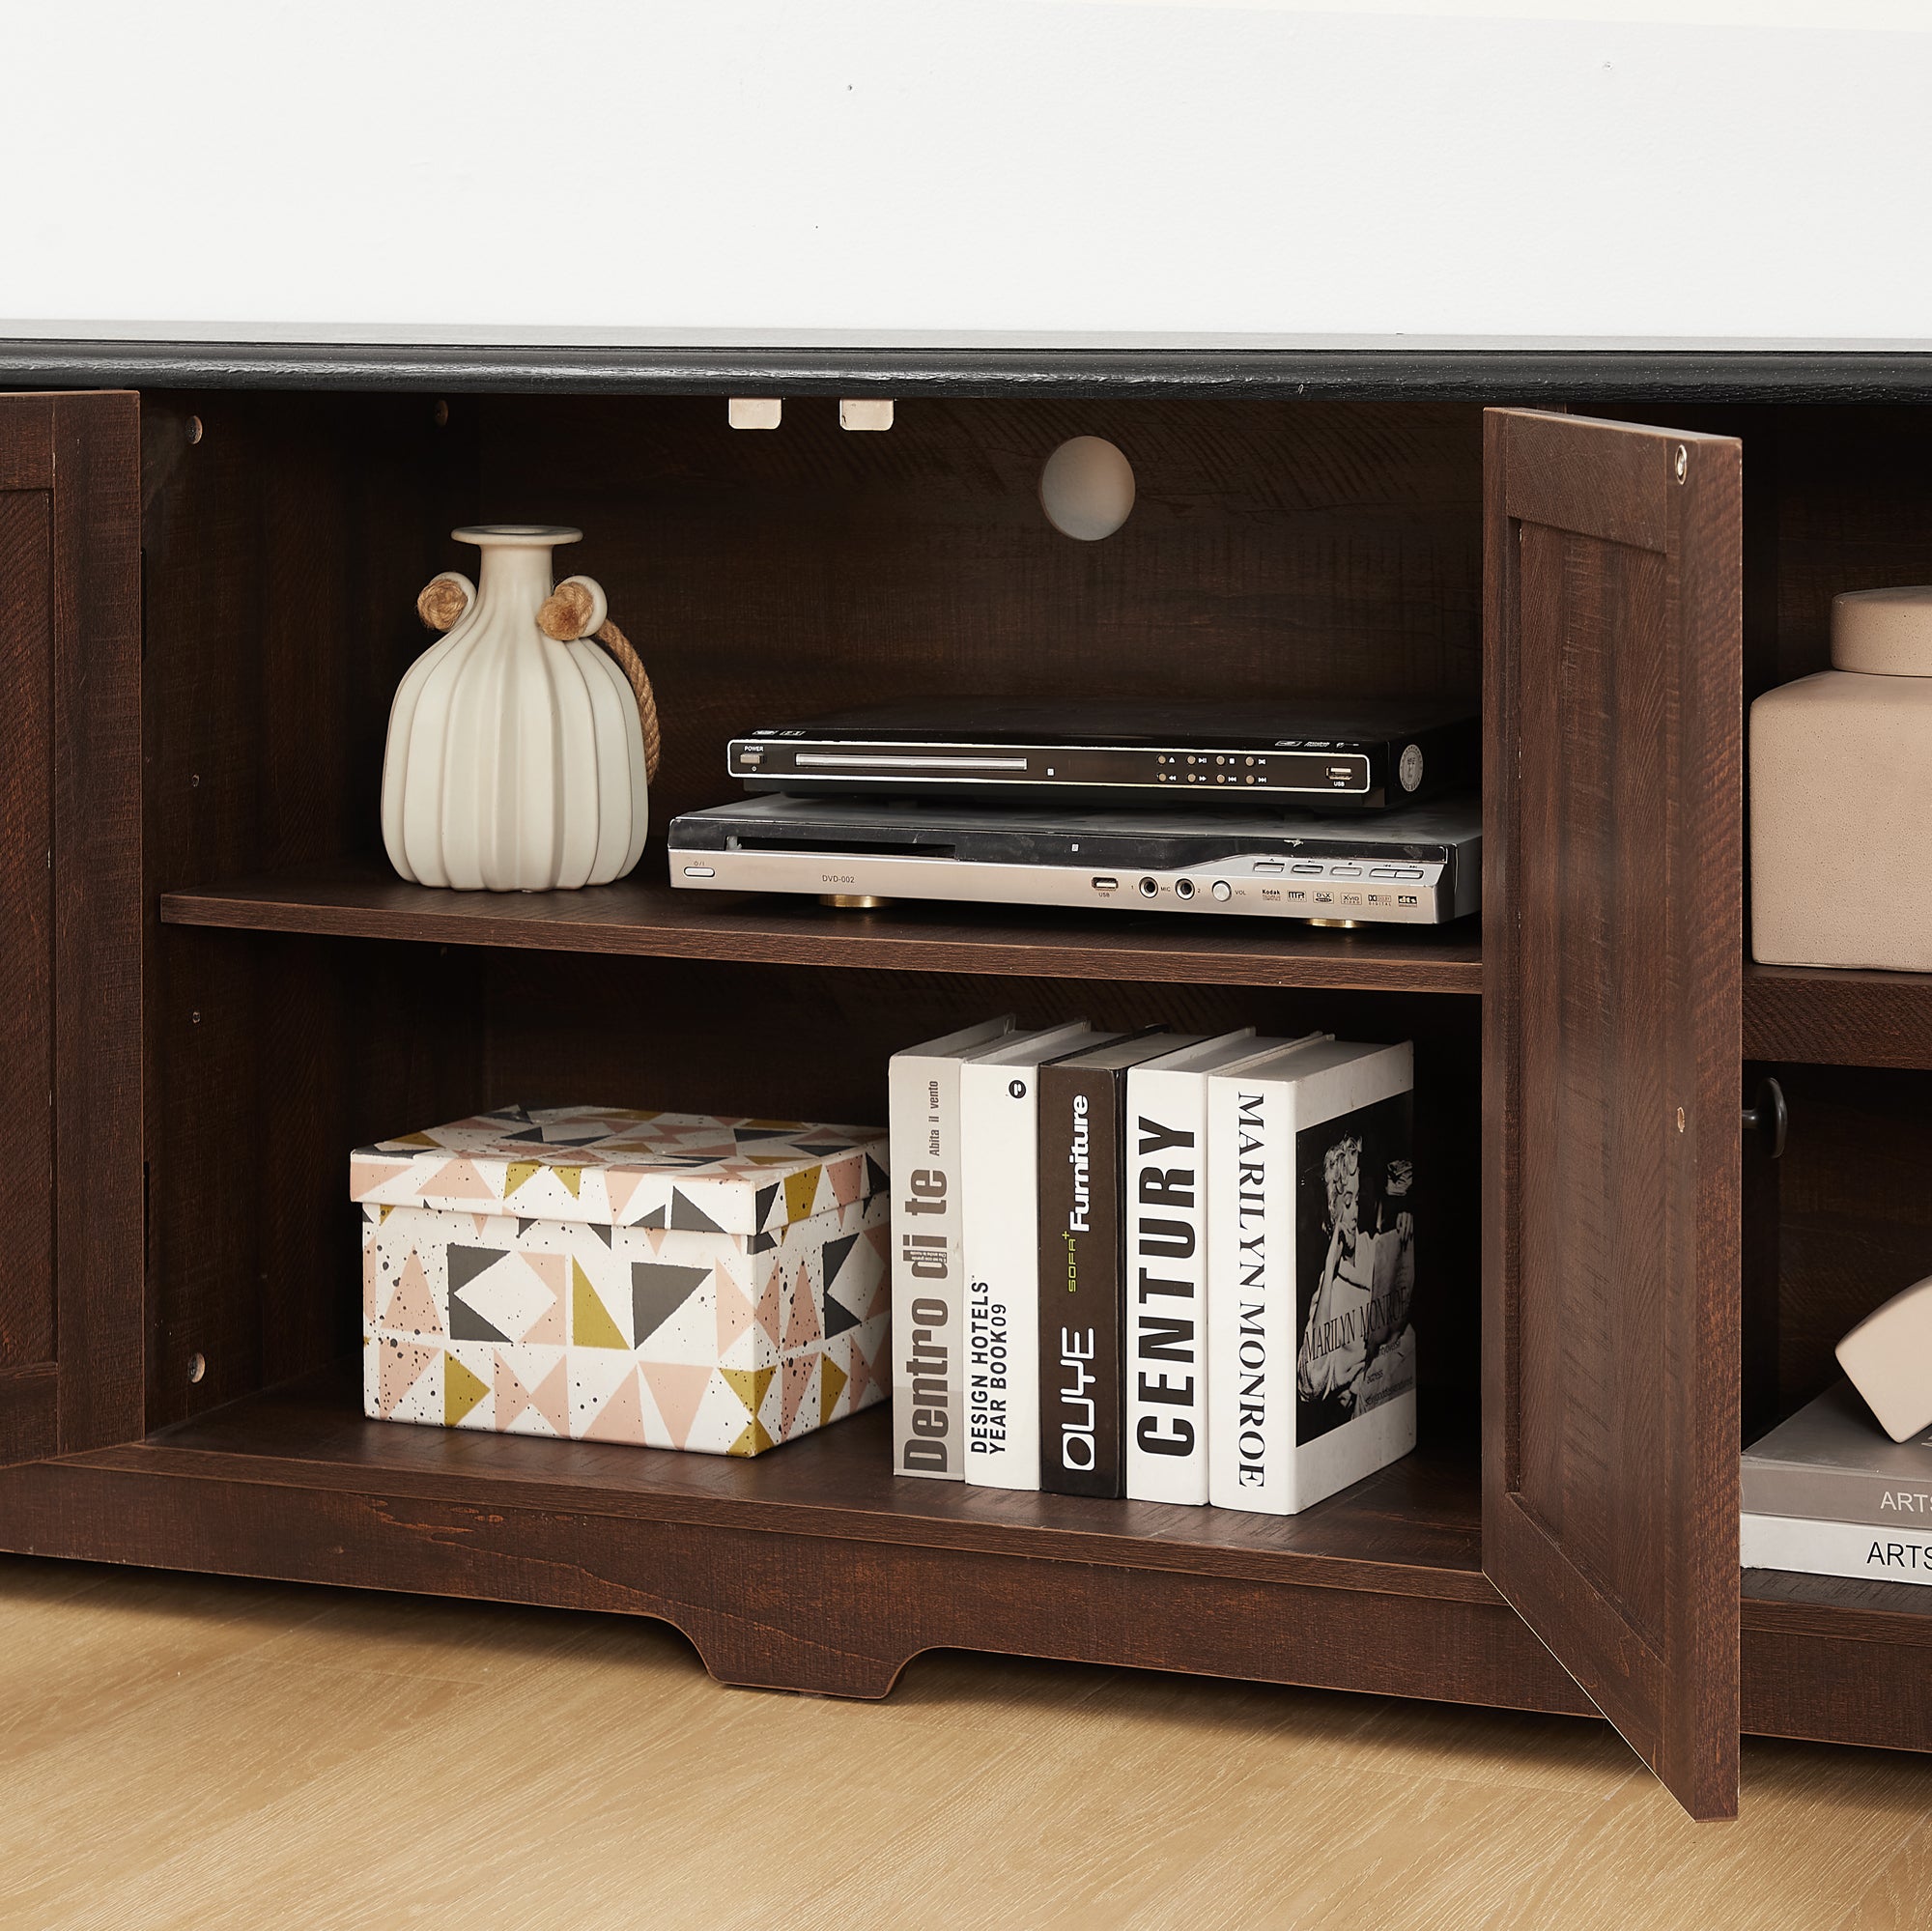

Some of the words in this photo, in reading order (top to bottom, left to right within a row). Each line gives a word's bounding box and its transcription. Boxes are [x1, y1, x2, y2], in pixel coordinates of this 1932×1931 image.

[928, 1081, 939, 1109] vento
[929, 1129, 940, 1156] Abita
[1069, 1094, 1090, 1232] Furniture
[904, 1169, 948, 1217] te
[1237, 1093, 1265, 1291] MARILYN
[902, 1235, 948, 1280] di
[1136, 1116, 1196, 1458] CENTURY
[990, 1304, 1007, 1390] BOOK09
[1304, 1310, 1355, 1364] MARILYN
[903, 1298, 949, 1473] Dentro
[971, 1375, 988, 1454] DESIGN
[1239, 1303, 1266, 1489] MONROE
[989, 1400, 1007, 1454] YEAR
[1880, 1491, 1932, 1513] ART
